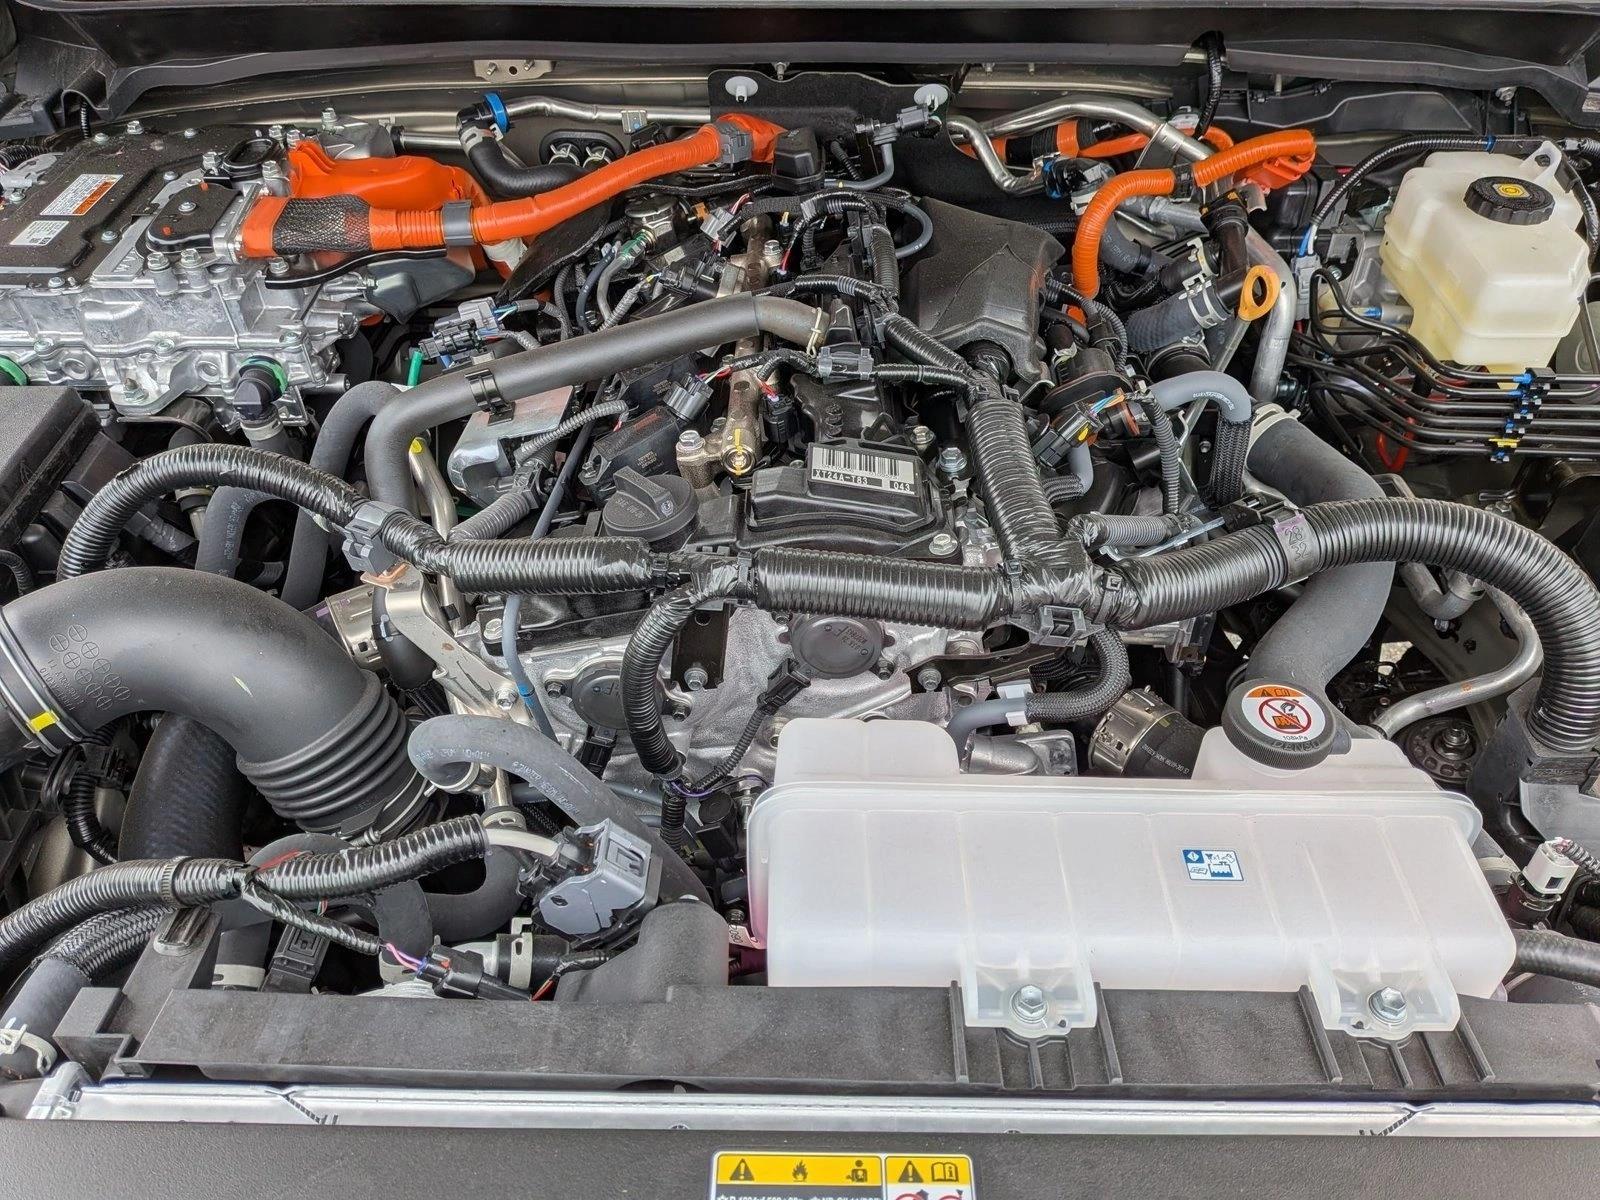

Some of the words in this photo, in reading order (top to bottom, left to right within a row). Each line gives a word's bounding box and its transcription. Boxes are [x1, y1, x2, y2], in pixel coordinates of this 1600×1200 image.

[893, 481, 911, 492] 043
[1284, 525, 1303, 546] 28
[1290, 541, 1311, 561] 32
[1271, 739, 1321, 752] DENSO
